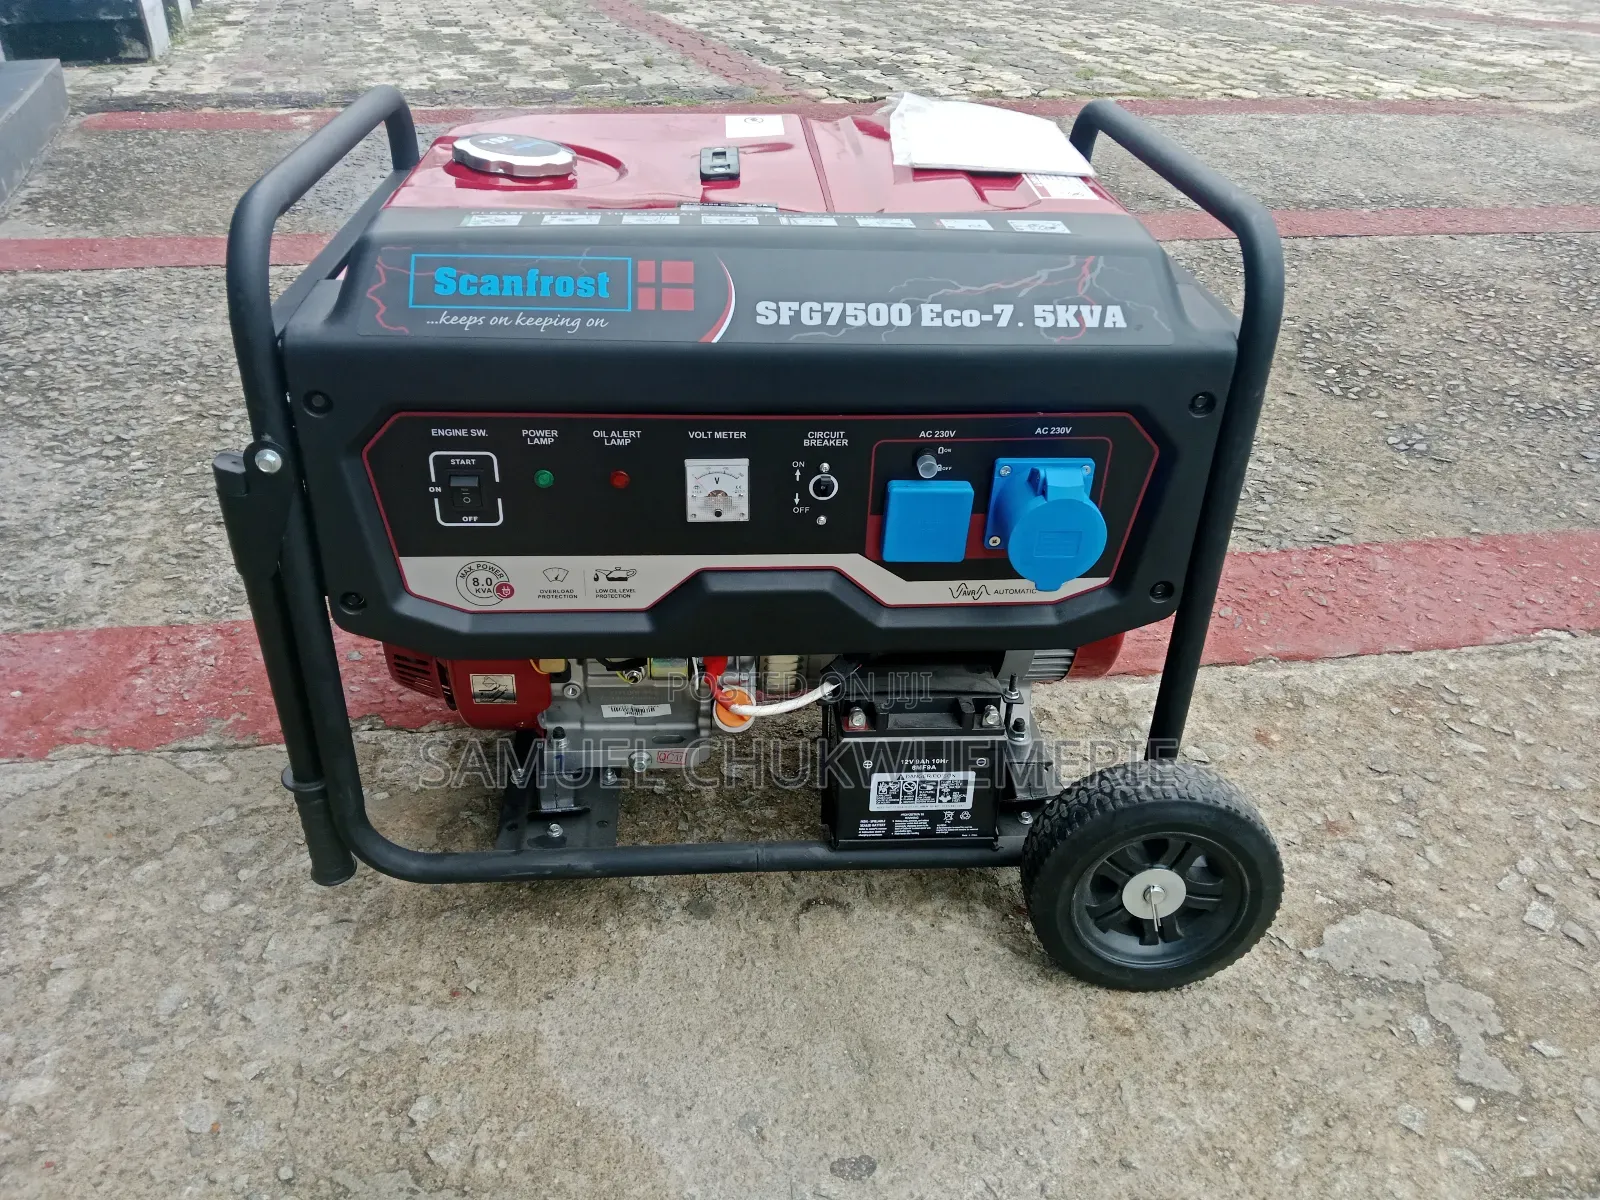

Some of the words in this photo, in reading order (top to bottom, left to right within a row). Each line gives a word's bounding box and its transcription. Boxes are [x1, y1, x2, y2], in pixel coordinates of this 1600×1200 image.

[434, 266, 610, 298] Scanfrost
[755, 300, 912, 327] SFG7500
[1034, 304, 1127, 329] 5KVA
[489, 316, 512, 327] on
[515, 312, 581, 333] keeping
[586, 318, 609, 329] on
[431, 428, 469, 437] ENGINE
[470, 428, 489, 437] SW.
[521, 429, 559, 438] POWER
[592, 430, 609, 438] OIL
[607, 430, 642, 438] ALERT
[688, 431, 713, 439] VOLT
[714, 431, 747, 439] METER
[807, 431, 845, 439] CIRCUIT
[919, 430, 933, 438] AC
[934, 430, 956, 438] 230V
[1035, 427, 1049, 435] AC
[1050, 426, 1072, 434] 230V
[527, 437, 555, 445] LAMP
[604, 438, 632, 446] LAMP
[803, 438, 849, 447] BREAKER
[792, 506, 810, 514] OFF
[459, 564, 474, 579] MAX
[476, 563, 505, 579] POWER
[472, 577, 493, 587] 8.0
